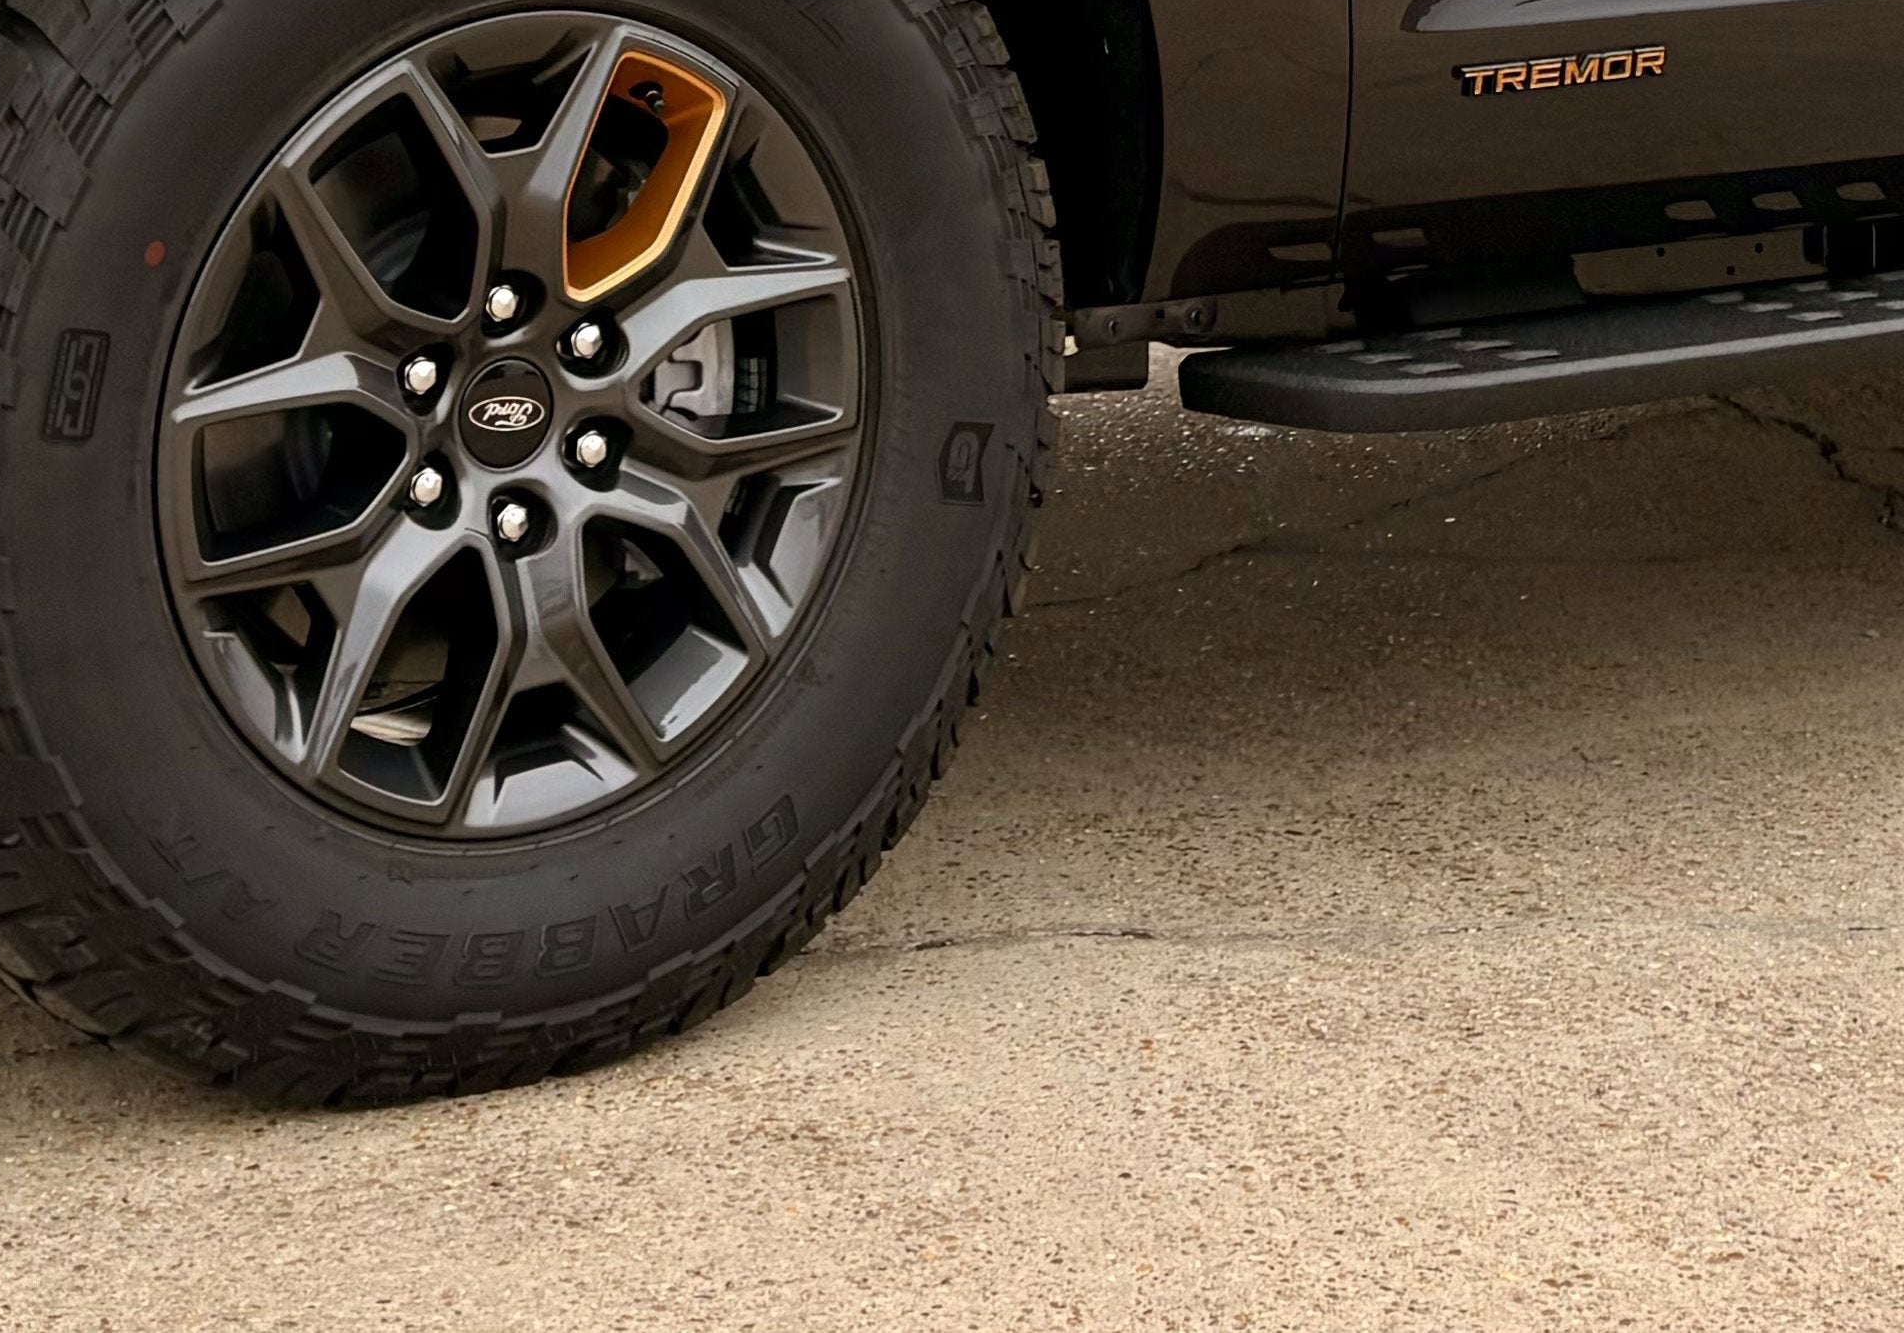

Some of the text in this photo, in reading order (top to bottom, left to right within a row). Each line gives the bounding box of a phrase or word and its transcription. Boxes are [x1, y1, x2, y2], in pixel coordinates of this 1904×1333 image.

[1460, 44, 1666, 96] TREMOR
[478, 400, 536, 427] Ford
[298, 791, 800, 989] GRABBER
